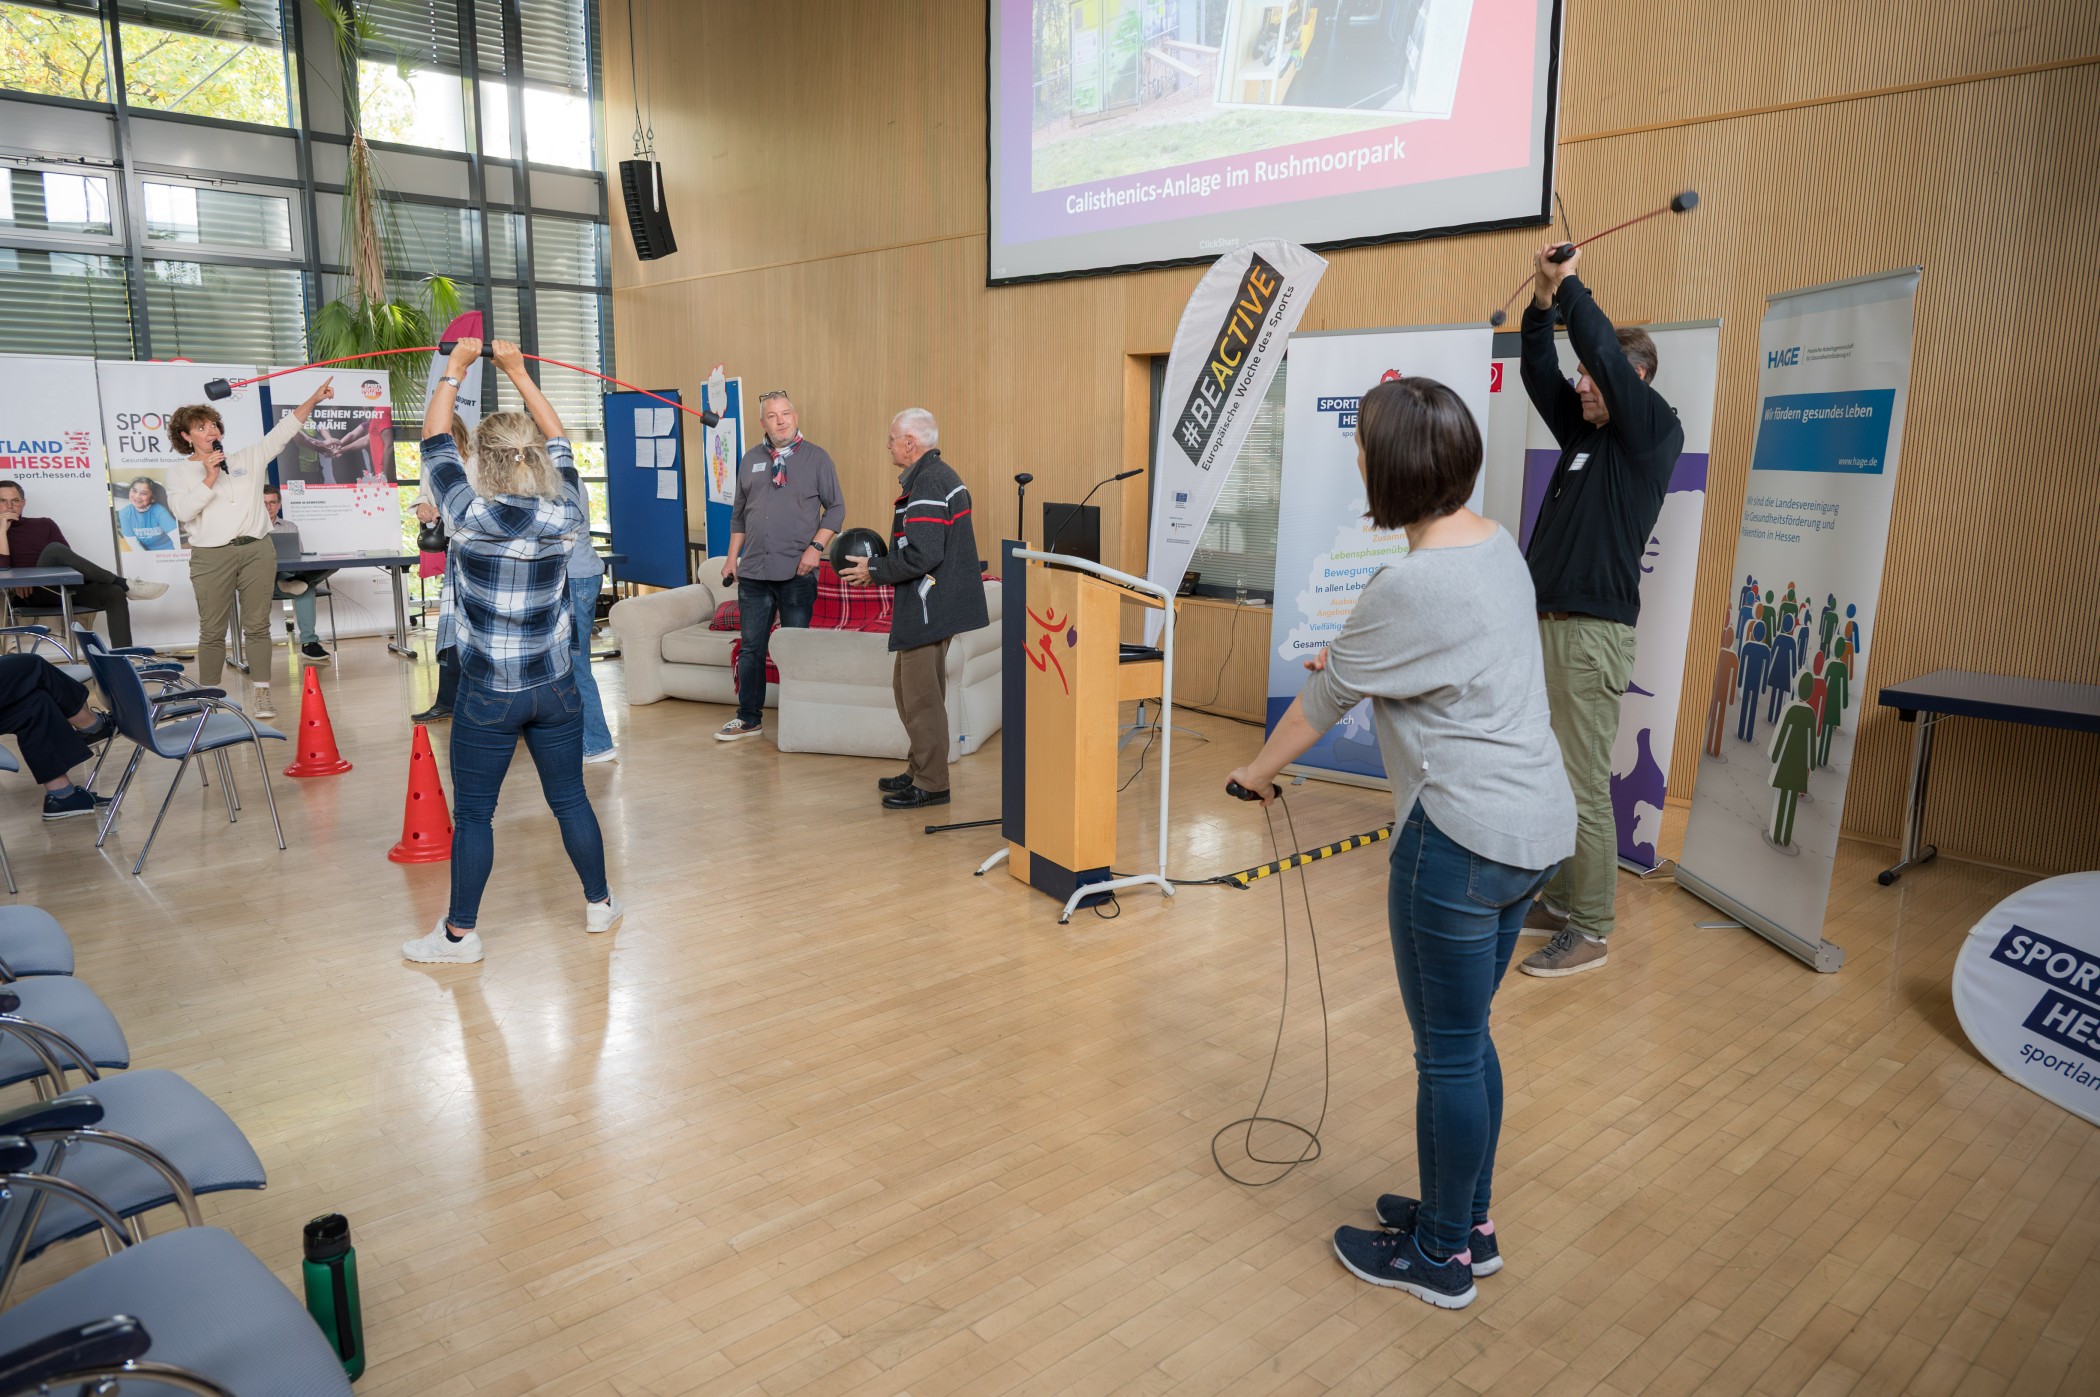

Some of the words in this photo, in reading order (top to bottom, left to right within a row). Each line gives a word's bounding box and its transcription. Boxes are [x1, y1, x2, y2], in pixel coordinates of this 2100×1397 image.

[1066, 173, 1221, 214] Calisthenics-Anlage
[1226, 166, 1249, 188] im
[1255, 136, 1406, 183] Rushmoorpark
[1199, 238, 1240, 250] ClickShare
[1181, 265, 1276, 449] #BEACTIVE
[1767, 346, 1801, 369] HAGE
[1202, 402, 1240, 471] Europäische
[1235, 356, 1262, 398] Woche
[1258, 331, 1273, 353] des
[1269, 286, 1294, 328] Sports
[314, 409, 351, 419] DEINEN
[352, 409, 385, 419] SPORT
[1764, 408, 1774, 420] Wir
[1774, 406, 1801, 420] fördern
[1802, 404, 1844, 423] gesundes
[1845, 403, 1873, 418] Leben
[303, 421, 317, 430] ER
[318, 419, 347, 431] NÄHE
[119, 431, 162, 453] FÜR
[1342, 431, 1355, 439] spo
[12, 456, 90, 469] HESSEN
[1838, 457, 1878, 468] www.hage.de
[14, 471, 91, 481] sport.hessen.de
[1753, 496, 1764, 506] sind
[1765, 496, 1775, 506] die
[1775, 498, 1840, 516] Landesvereinigung
[1750, 511, 1821, 532] Gesundheitsförderung
[1822, 519, 1836, 530] und
[1766, 530, 1774, 540] in
[1775, 531, 1801, 543] Hessen
[1330, 545, 1409, 560] Lebensphasenübe
[1324, 562, 1386, 578] Bewegungs
[1315, 585, 1323, 593] In
[1325, 583, 1344, 592] allen
[1346, 582, 1366, 591] Lebe
[2004, 935, 2100, 996] SPOR
